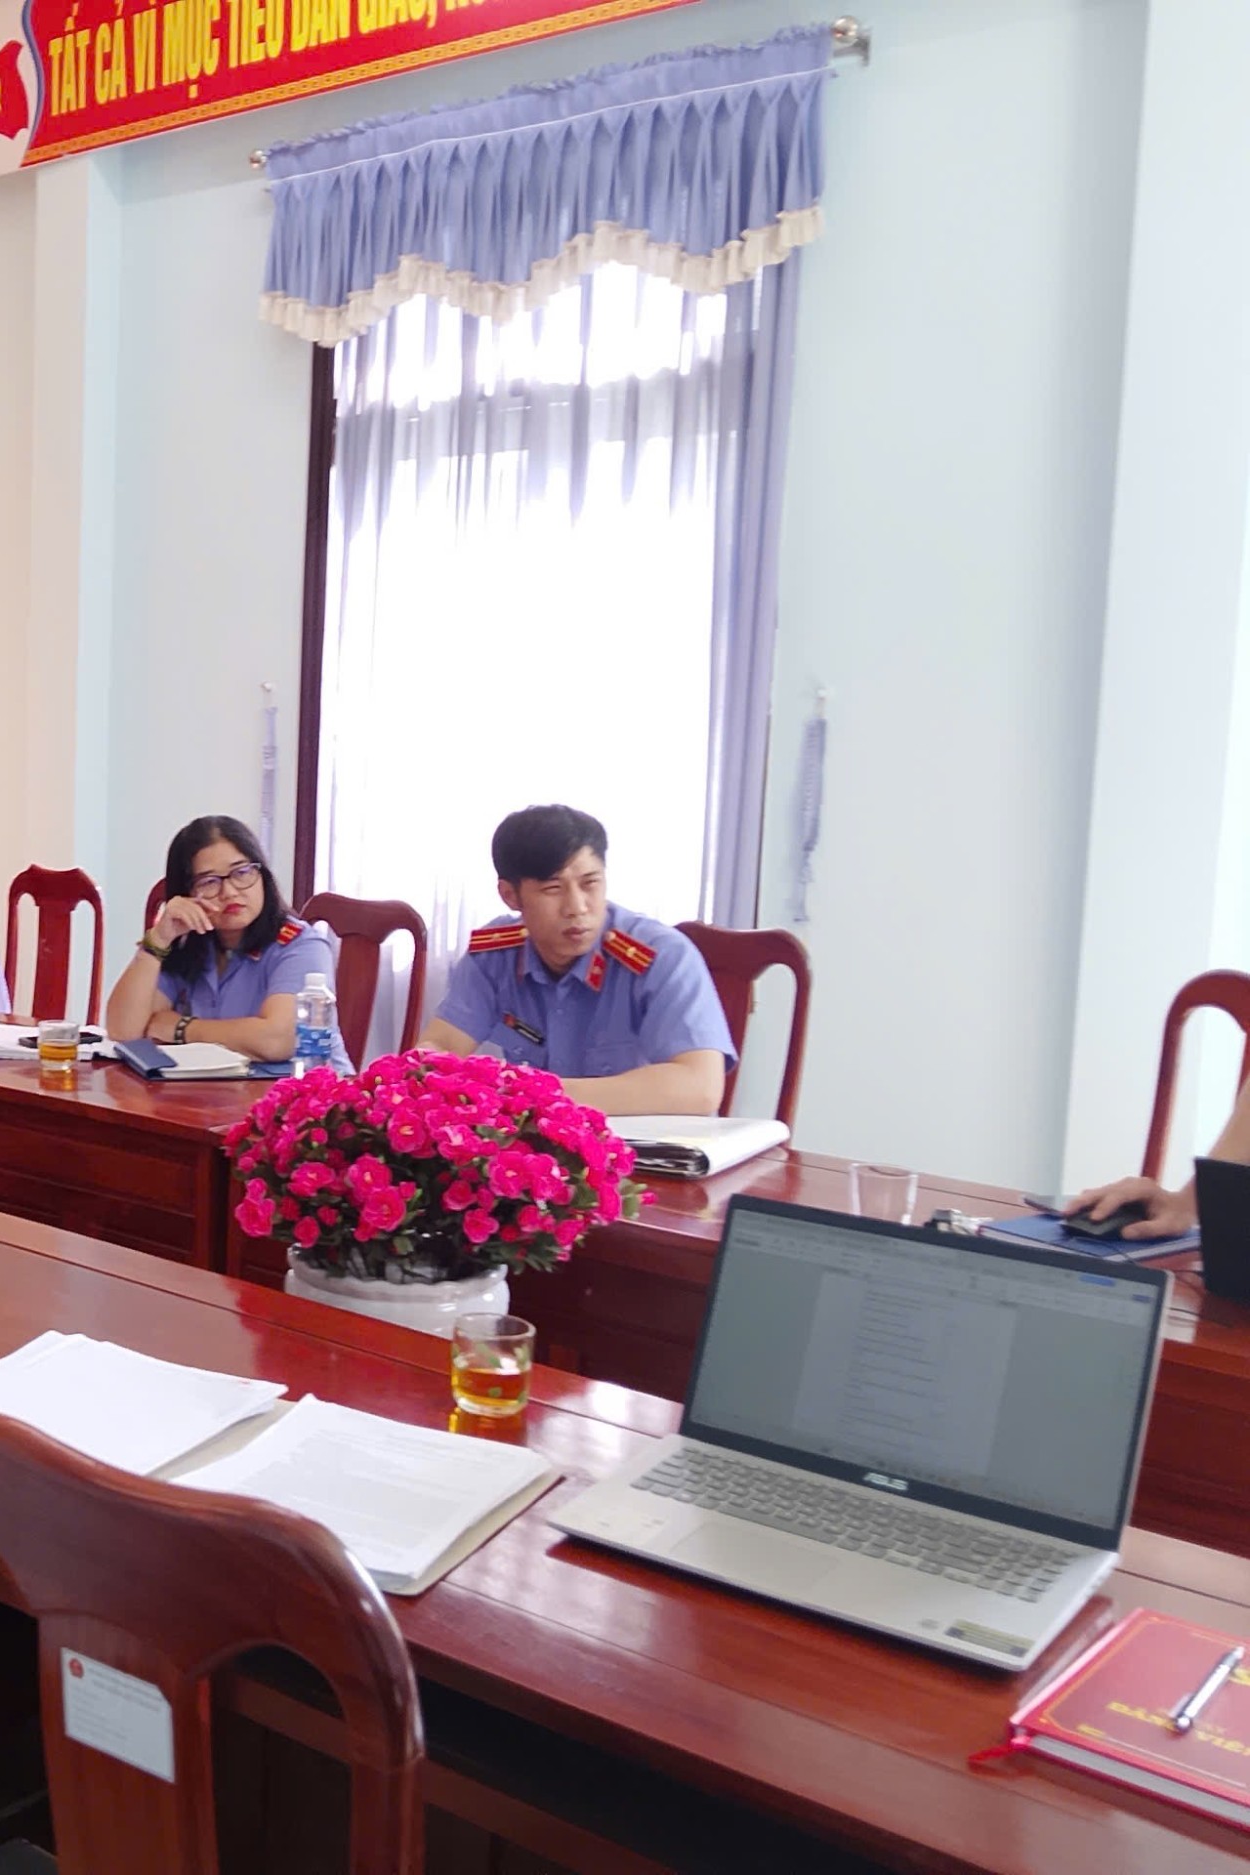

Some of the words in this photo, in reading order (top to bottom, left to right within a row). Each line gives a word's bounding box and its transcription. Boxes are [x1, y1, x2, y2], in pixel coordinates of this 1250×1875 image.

[49, 3, 90, 116] TẤT
[95, 0, 127, 104] CẢ
[162, 0, 220, 98] MỤC
